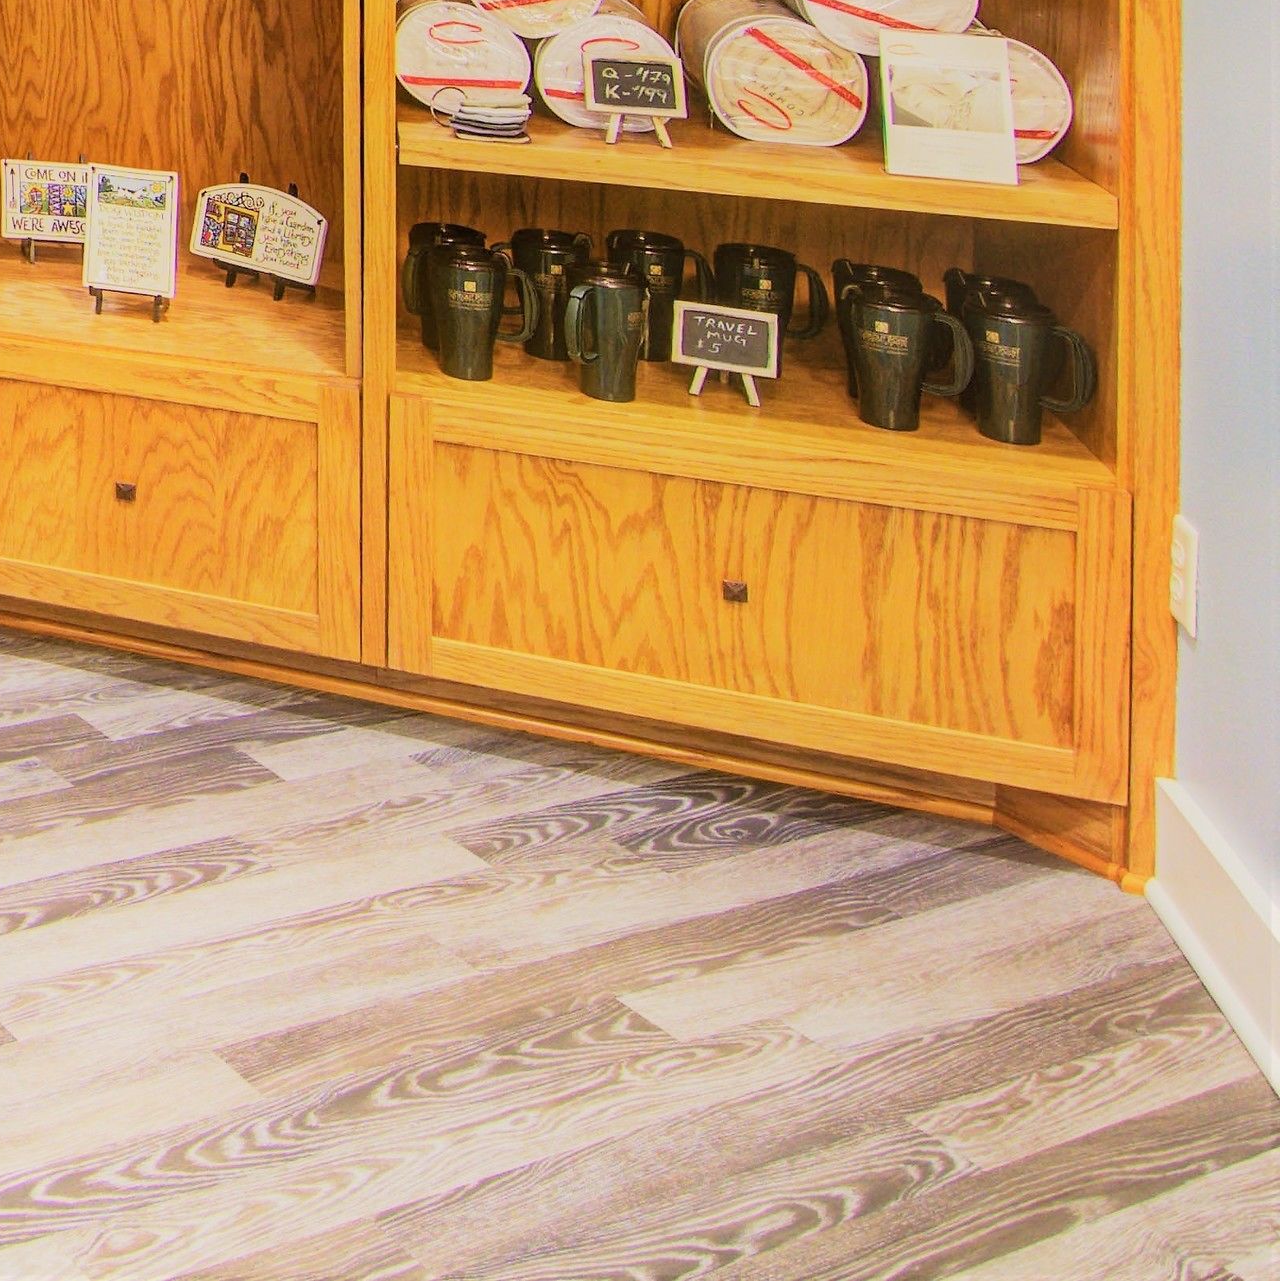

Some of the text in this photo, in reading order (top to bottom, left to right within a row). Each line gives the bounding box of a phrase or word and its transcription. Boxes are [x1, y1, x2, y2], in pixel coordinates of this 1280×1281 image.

[601, 67, 619, 80] Q
[605, 83, 620, 100] K
[24, 167, 76, 183] COME ON
[693, 316, 759, 337] TRAVEL
[706, 330, 747, 348] MUG
